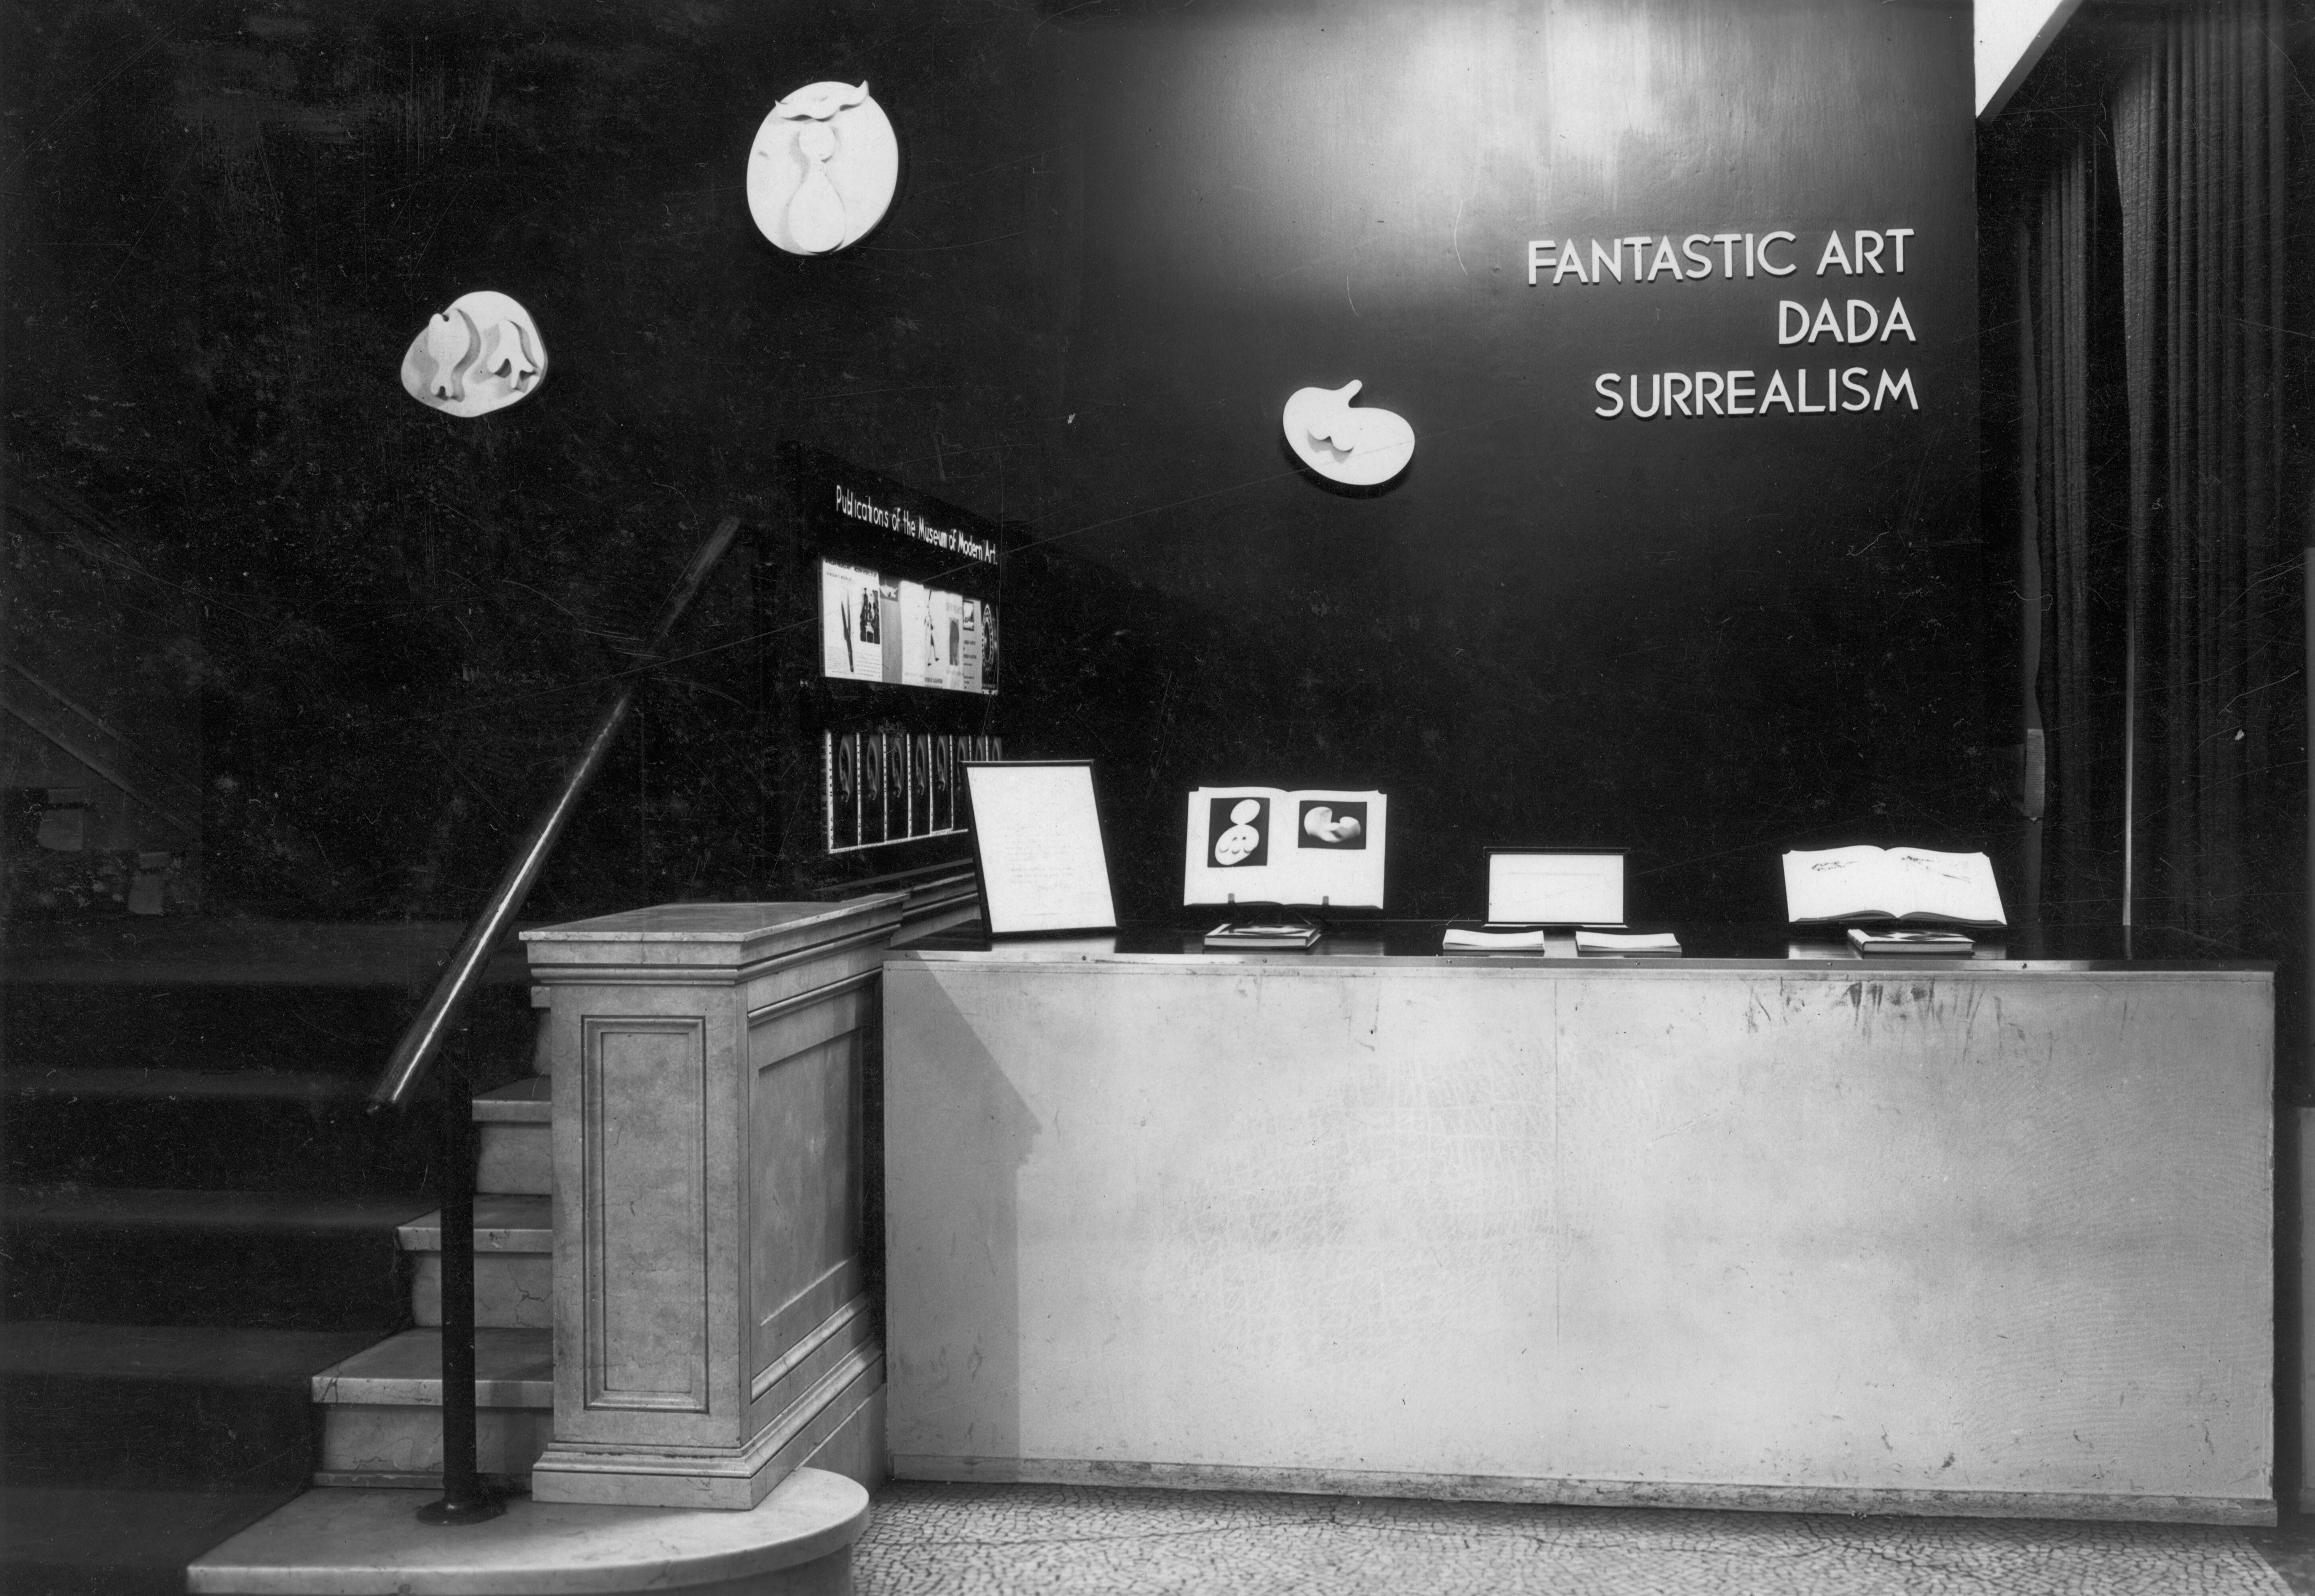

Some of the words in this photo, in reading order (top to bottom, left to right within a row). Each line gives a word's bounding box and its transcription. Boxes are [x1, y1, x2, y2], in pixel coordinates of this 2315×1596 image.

[1528, 231, 1797, 284] FANTASTIC
[1817, 228, 1915, 275] ART
[1779, 297, 1916, 345] DADA
[1595, 367, 1919, 418] SURREALISM
[836, 484, 889, 528] Publications
[892, 507, 901, 532] of
[903, 510, 916, 538] the
[918, 515, 948, 549] Museum
[949, 529, 957, 551] of
[957, 530, 983, 561] Modern
